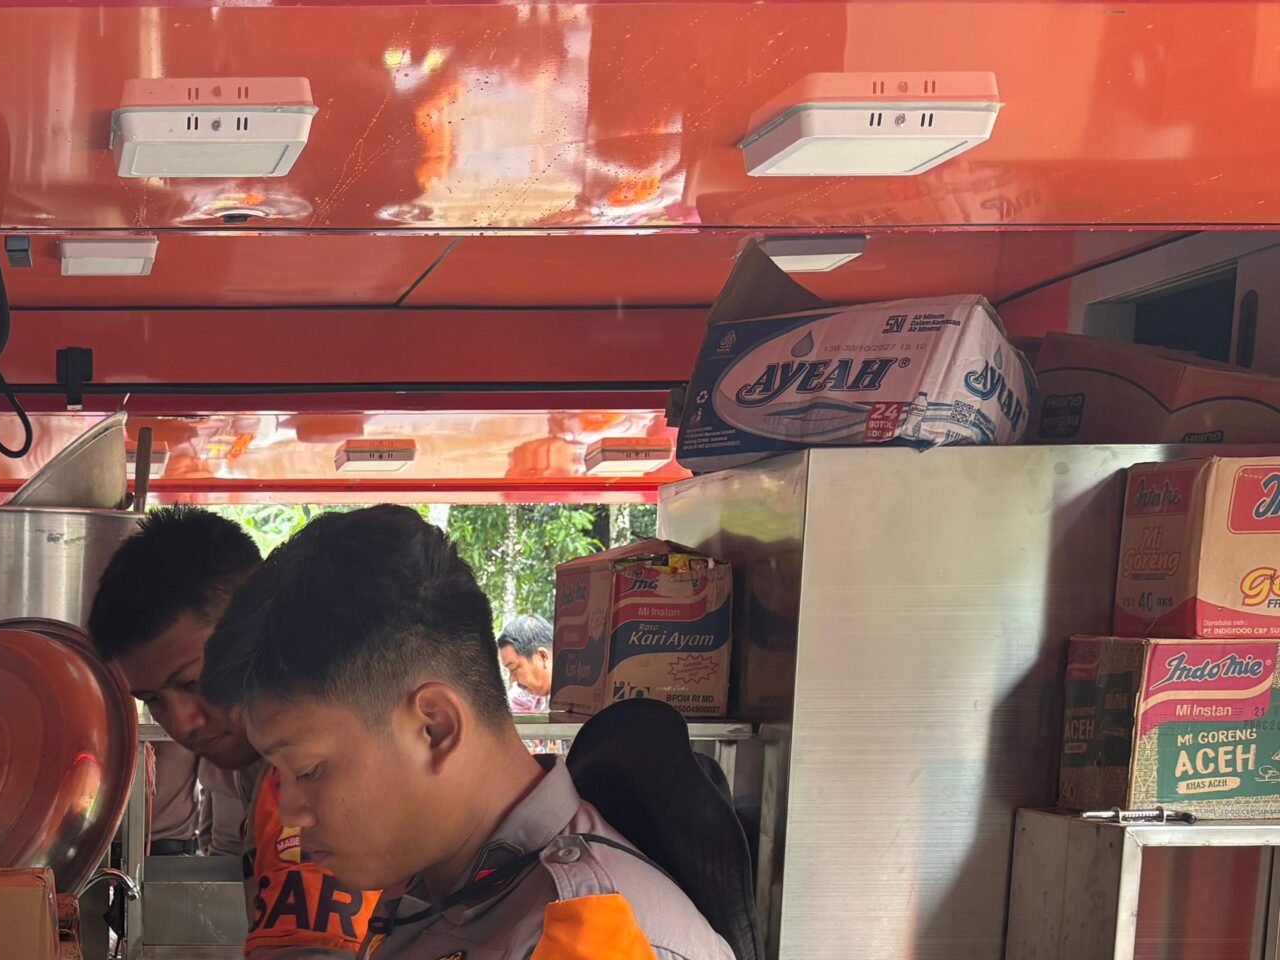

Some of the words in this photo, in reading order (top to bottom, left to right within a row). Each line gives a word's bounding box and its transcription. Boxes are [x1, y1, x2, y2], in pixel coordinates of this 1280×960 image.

[736, 357, 898, 408] AYEAH
[870, 404, 898, 419] 24
[638, 607, 649, 617] Mi
[651, 607, 680, 617] Instan
[639, 623, 659, 632] Rasa
[628, 631, 668, 646] Kari
[666, 631, 714, 650] Ayam
[666, 693, 692, 703] BPOM
[693, 694, 702, 703] RI
[702, 694, 714, 703] MD
[1176, 705, 1191, 716] Mi
[1193, 705, 1232, 716] Instan
[1177, 734, 1193, 747] MI
[1198, 728, 1257, 744] GORENG
[1175, 744, 1257, 777] ACEH
[1185, 780, 1206, 791] KHAS
[1208, 779, 1228, 790] ACEH
[277, 835, 301, 851] MABE
[248, 870, 359, 939] SAR
